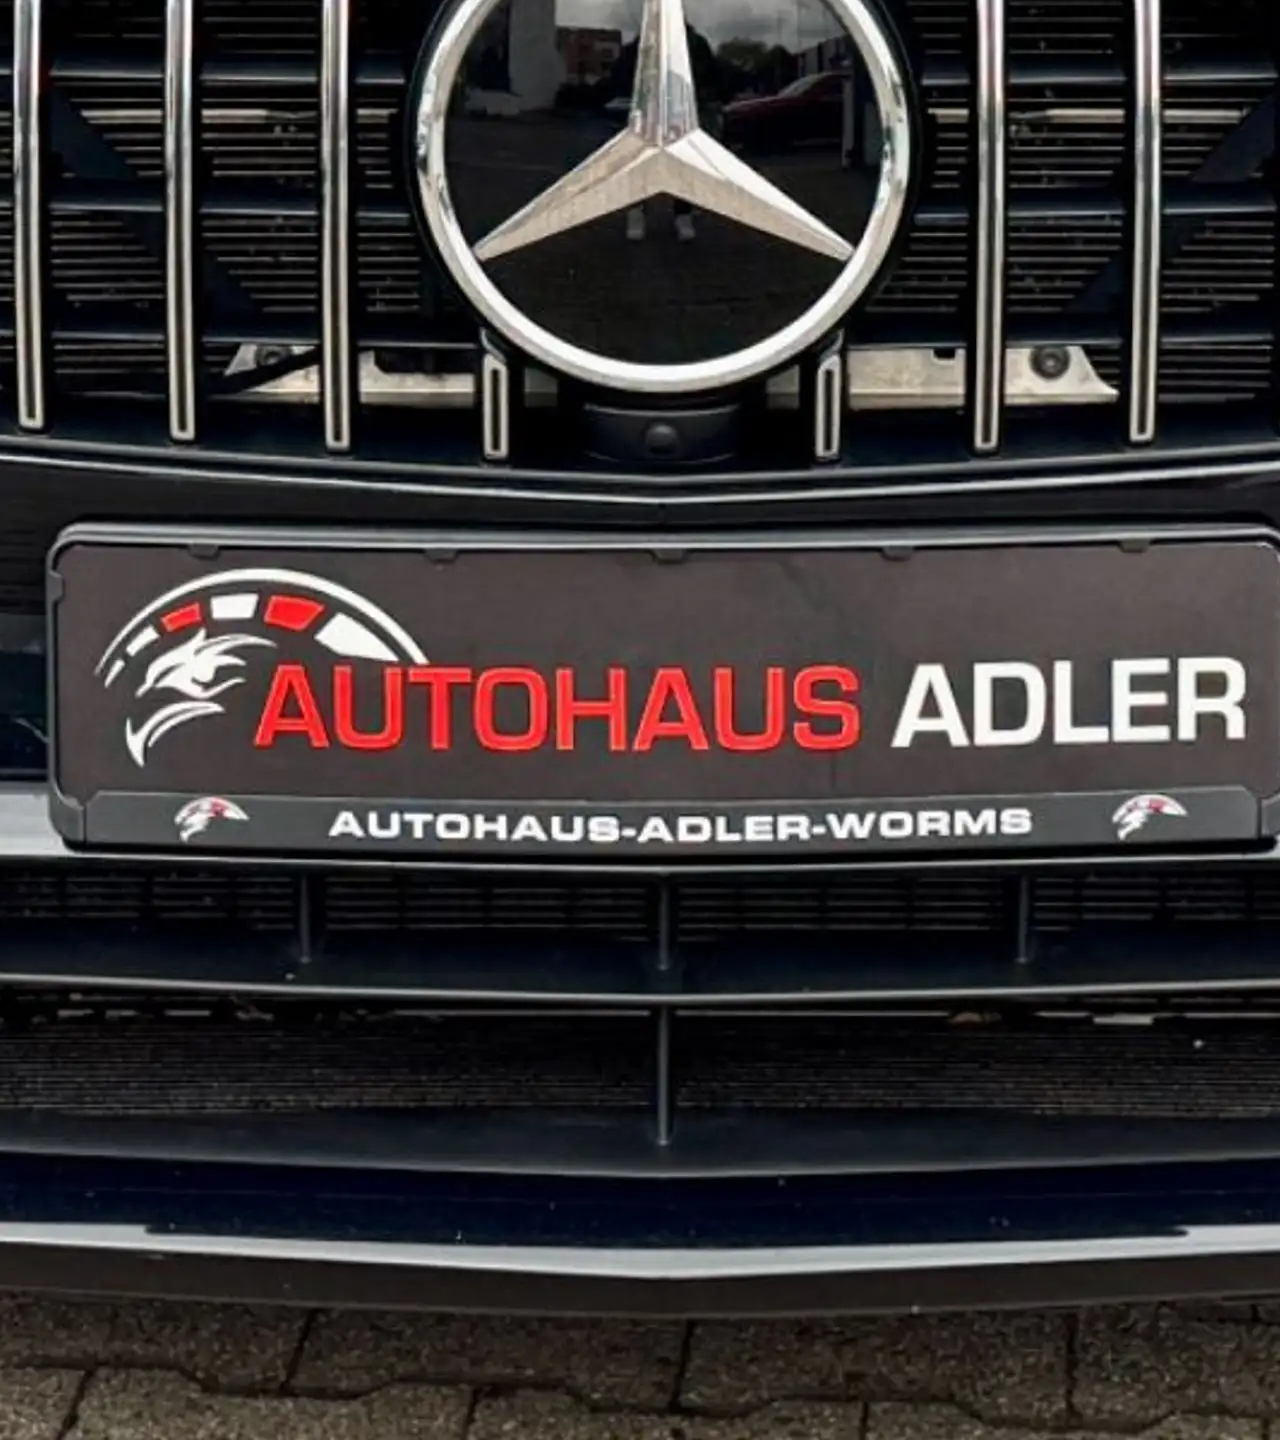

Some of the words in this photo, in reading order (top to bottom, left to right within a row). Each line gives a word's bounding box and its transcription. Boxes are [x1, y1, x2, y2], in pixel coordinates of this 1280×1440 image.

[253, 664, 861, 752] AUTOHAUS
[890, 656, 1247, 749] ADLER
[327, 807, 1033, 843] AUTOHAUS-ADLER-WORMS
